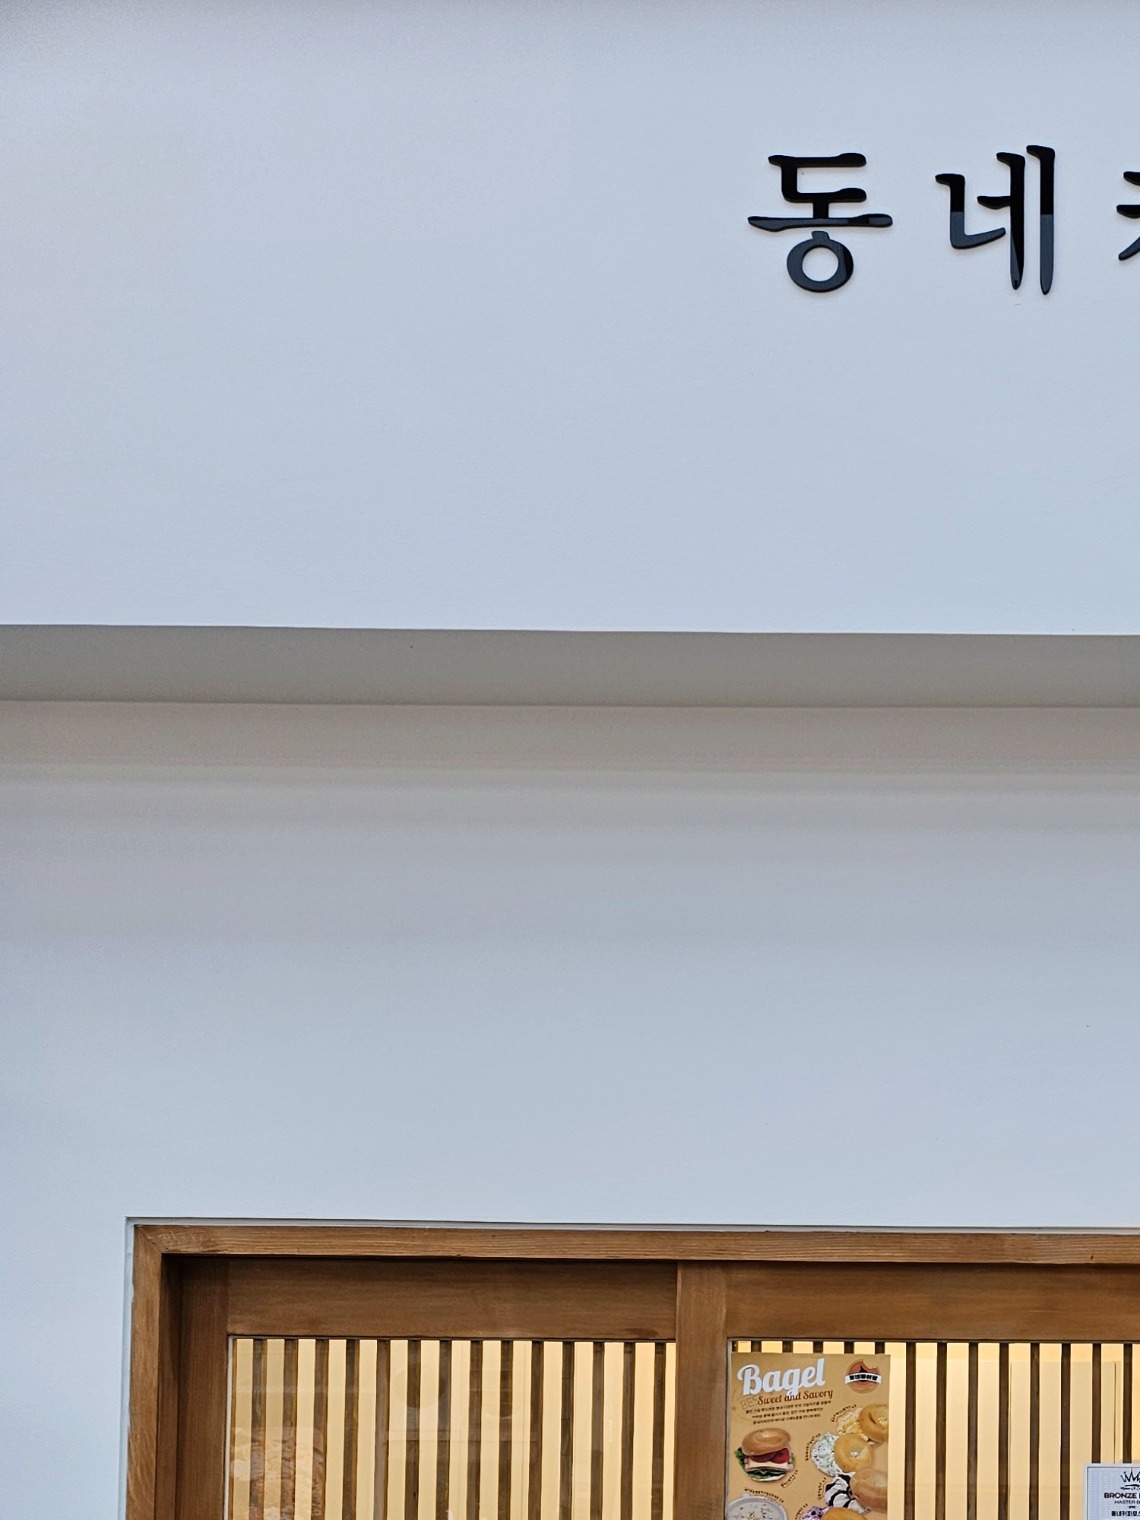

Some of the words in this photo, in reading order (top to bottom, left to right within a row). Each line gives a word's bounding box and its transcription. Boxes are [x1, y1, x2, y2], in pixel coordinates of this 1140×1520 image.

[737, 1358, 826, 1397] Bagel
[757, 1395, 783, 1405] Sweet
[784, 1391, 801, 1402] and
[802, 1390, 833, 1402] Savory
